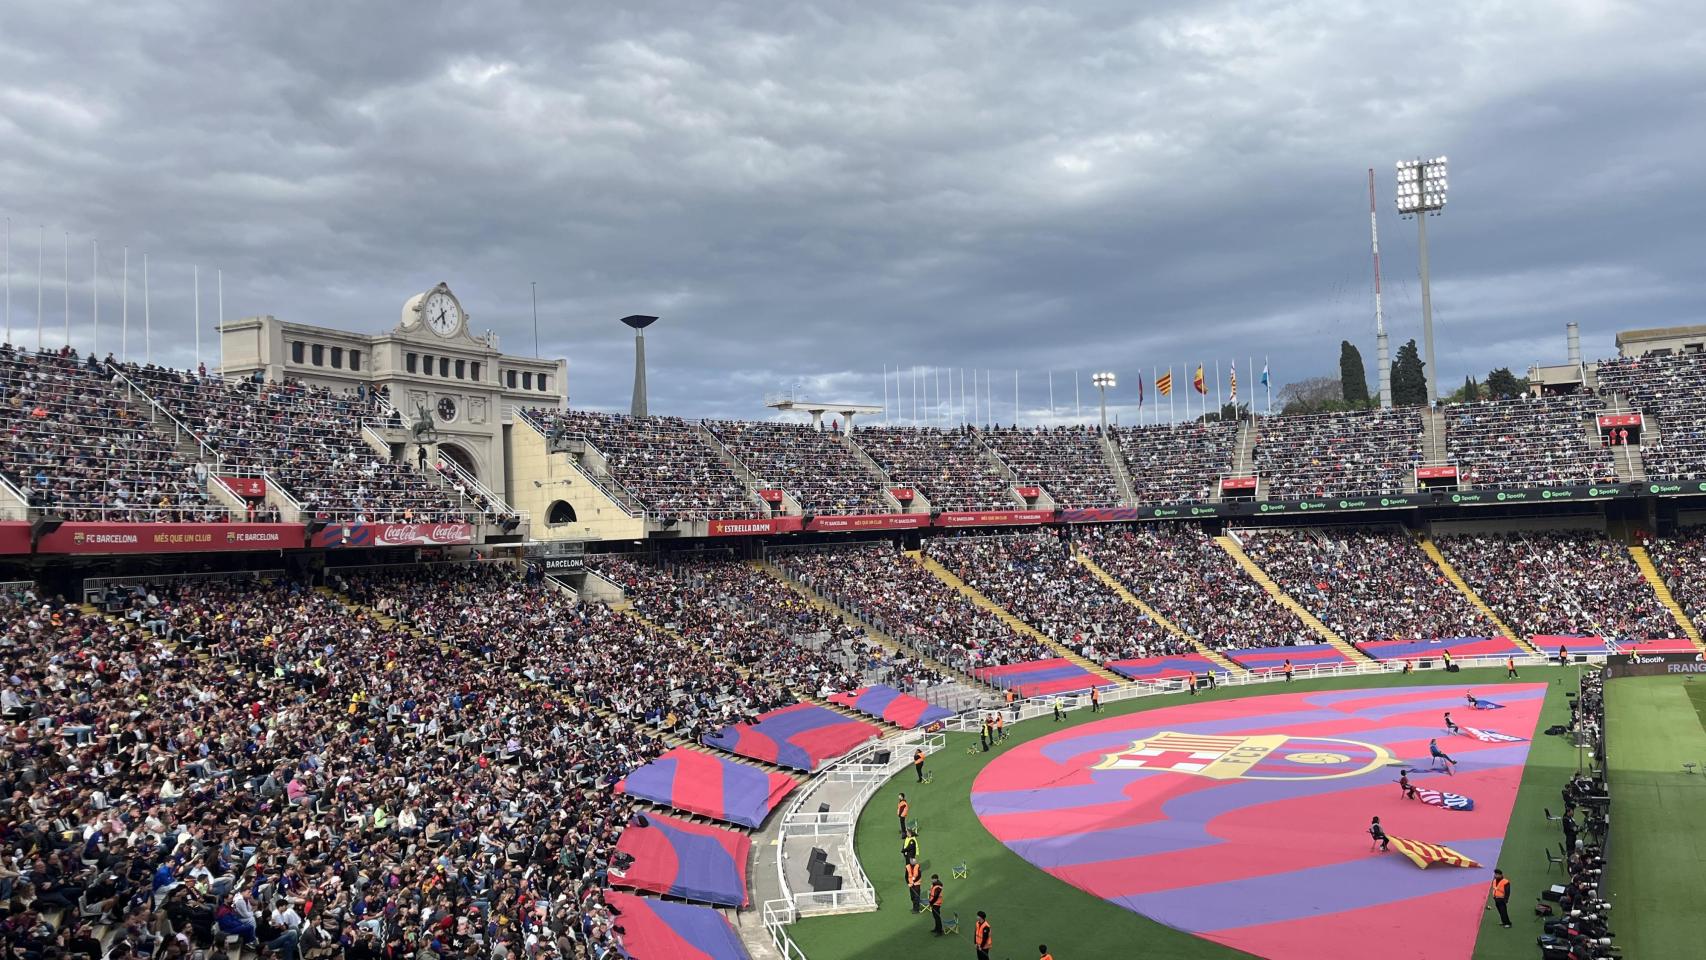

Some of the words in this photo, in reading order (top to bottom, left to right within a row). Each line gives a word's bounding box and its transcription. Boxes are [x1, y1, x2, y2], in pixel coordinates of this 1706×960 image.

[86, 534, 95, 543] FC
[96, 534, 138, 543] BARCELONA
[170, 534, 183, 544] QUE
[546, 560, 584, 568] BARCELONA
